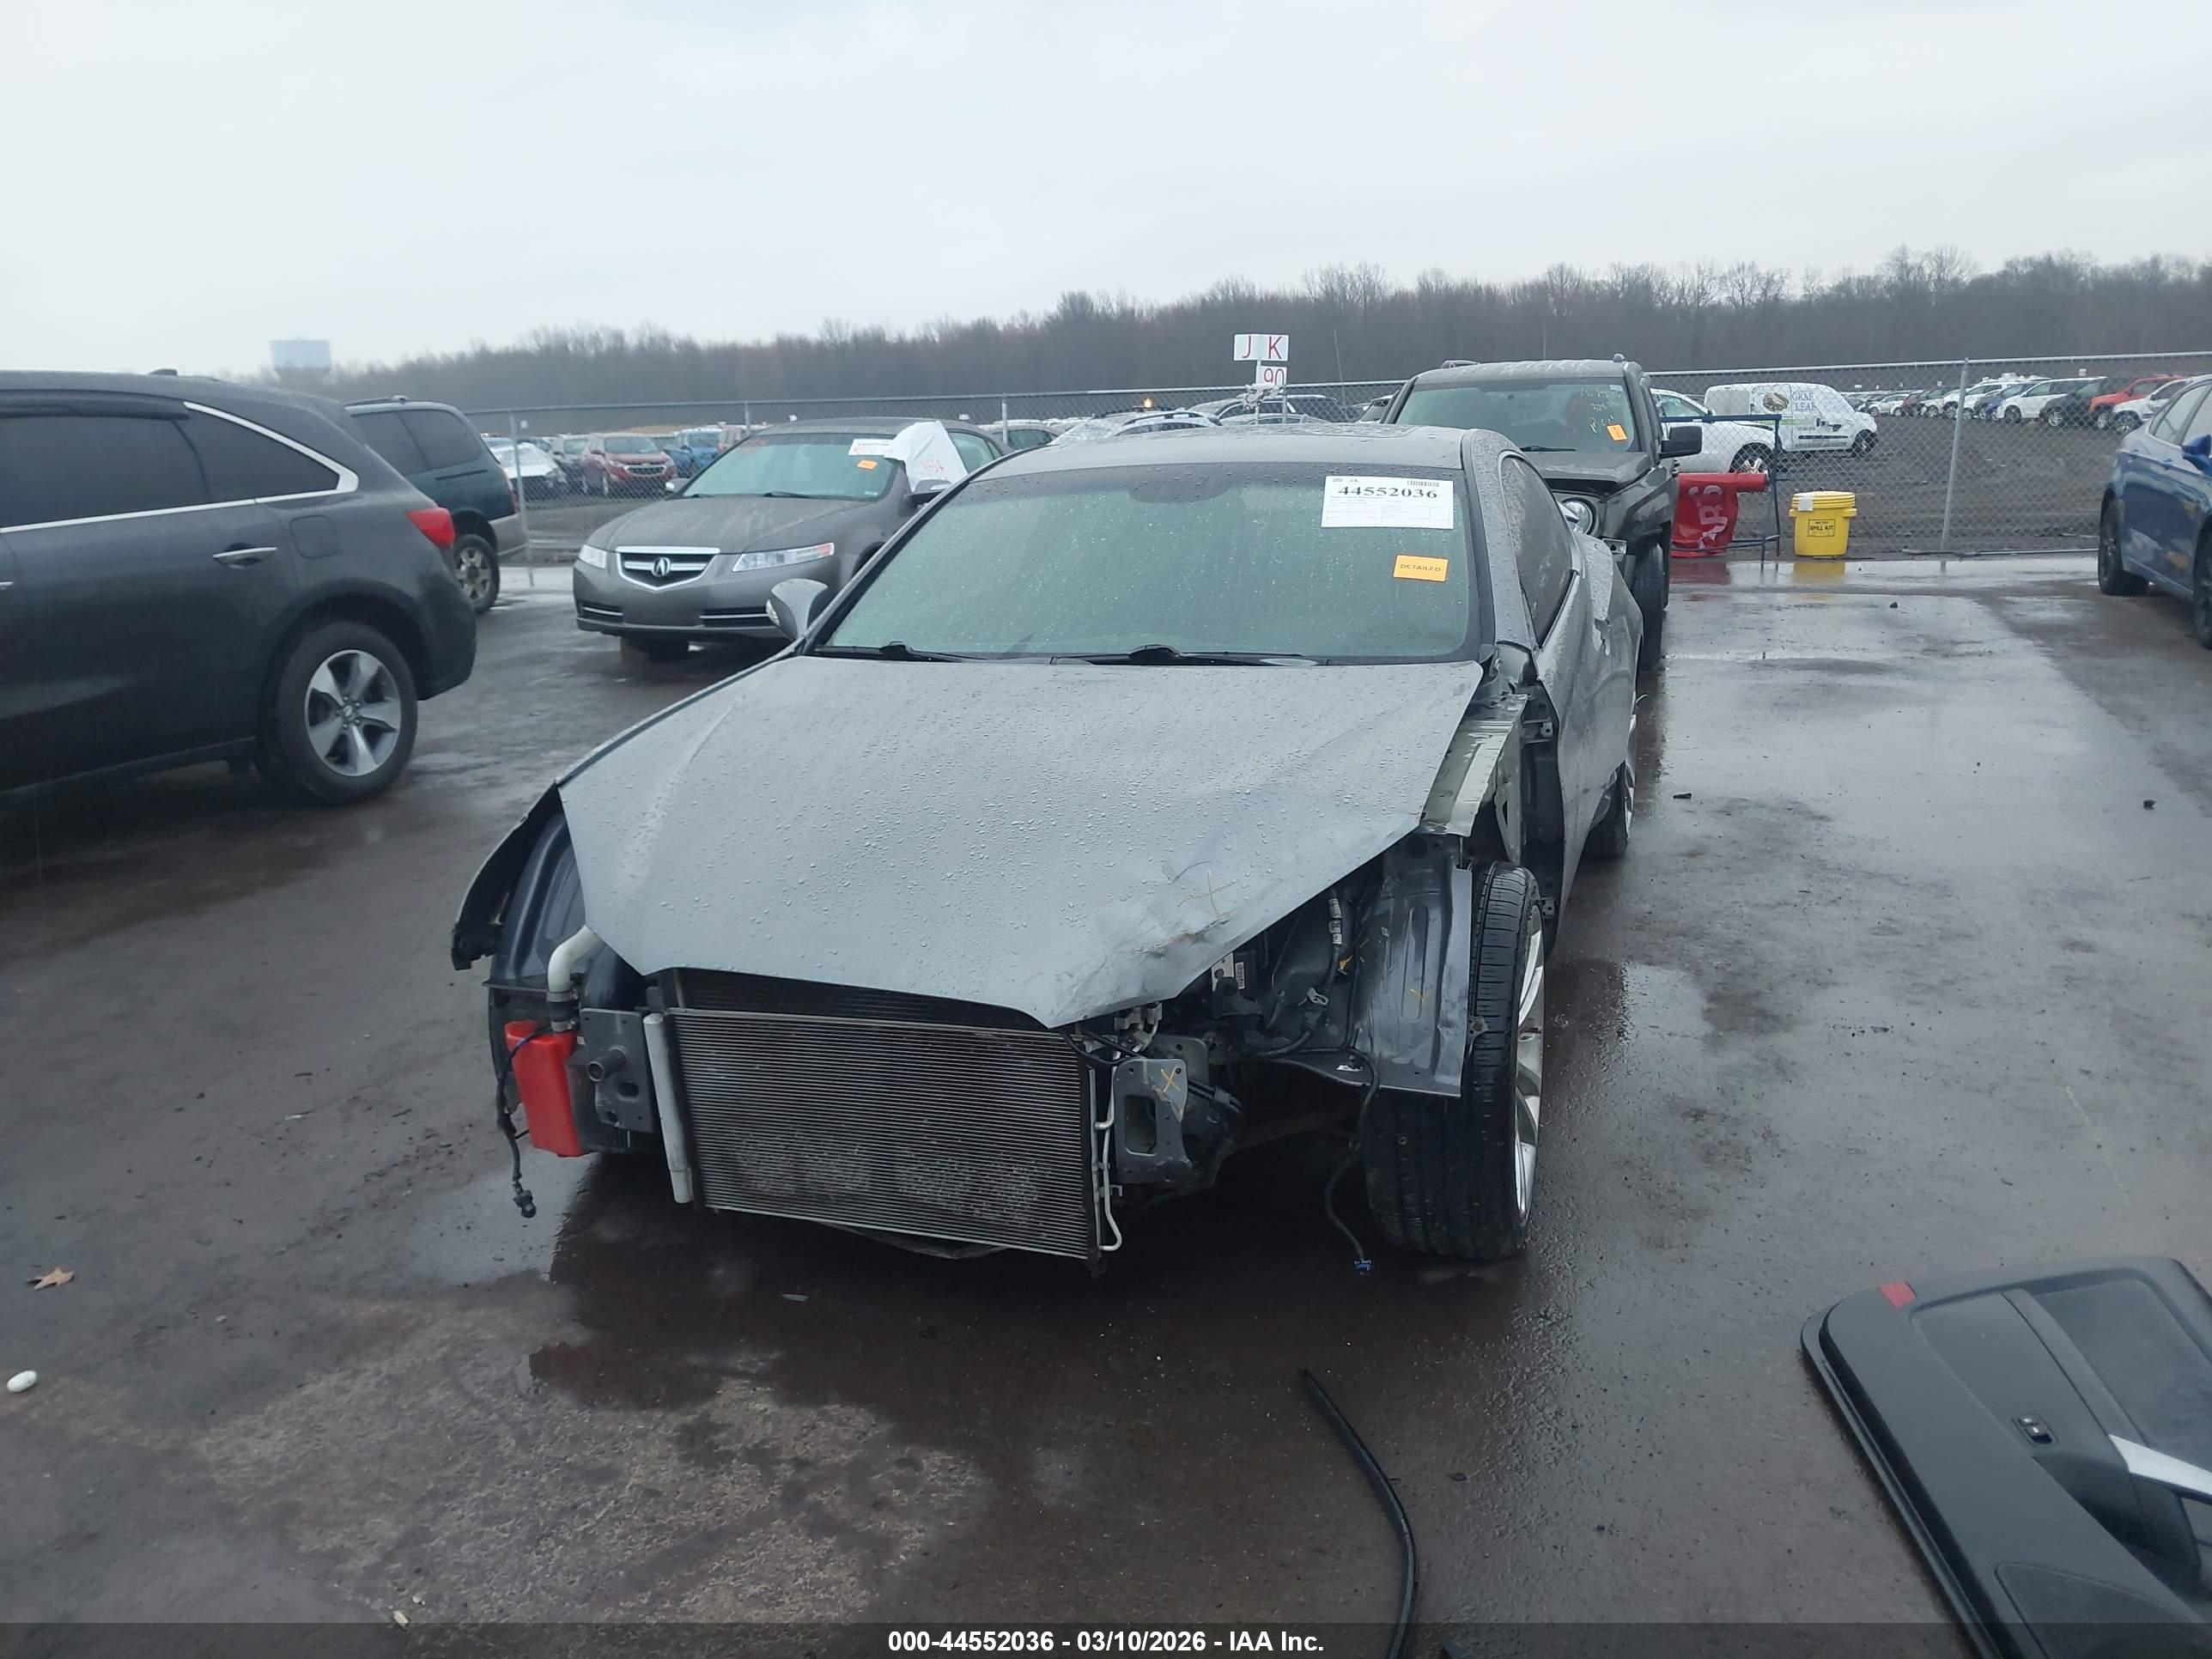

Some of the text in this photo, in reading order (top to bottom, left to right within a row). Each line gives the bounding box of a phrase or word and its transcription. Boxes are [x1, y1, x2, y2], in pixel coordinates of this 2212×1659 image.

[1242, 336, 1282, 359] J K
[1263, 368, 1285, 386] 90
[1338, 485, 1437, 499] 44552036
[1400, 563, 1442, 572] DETAILED
